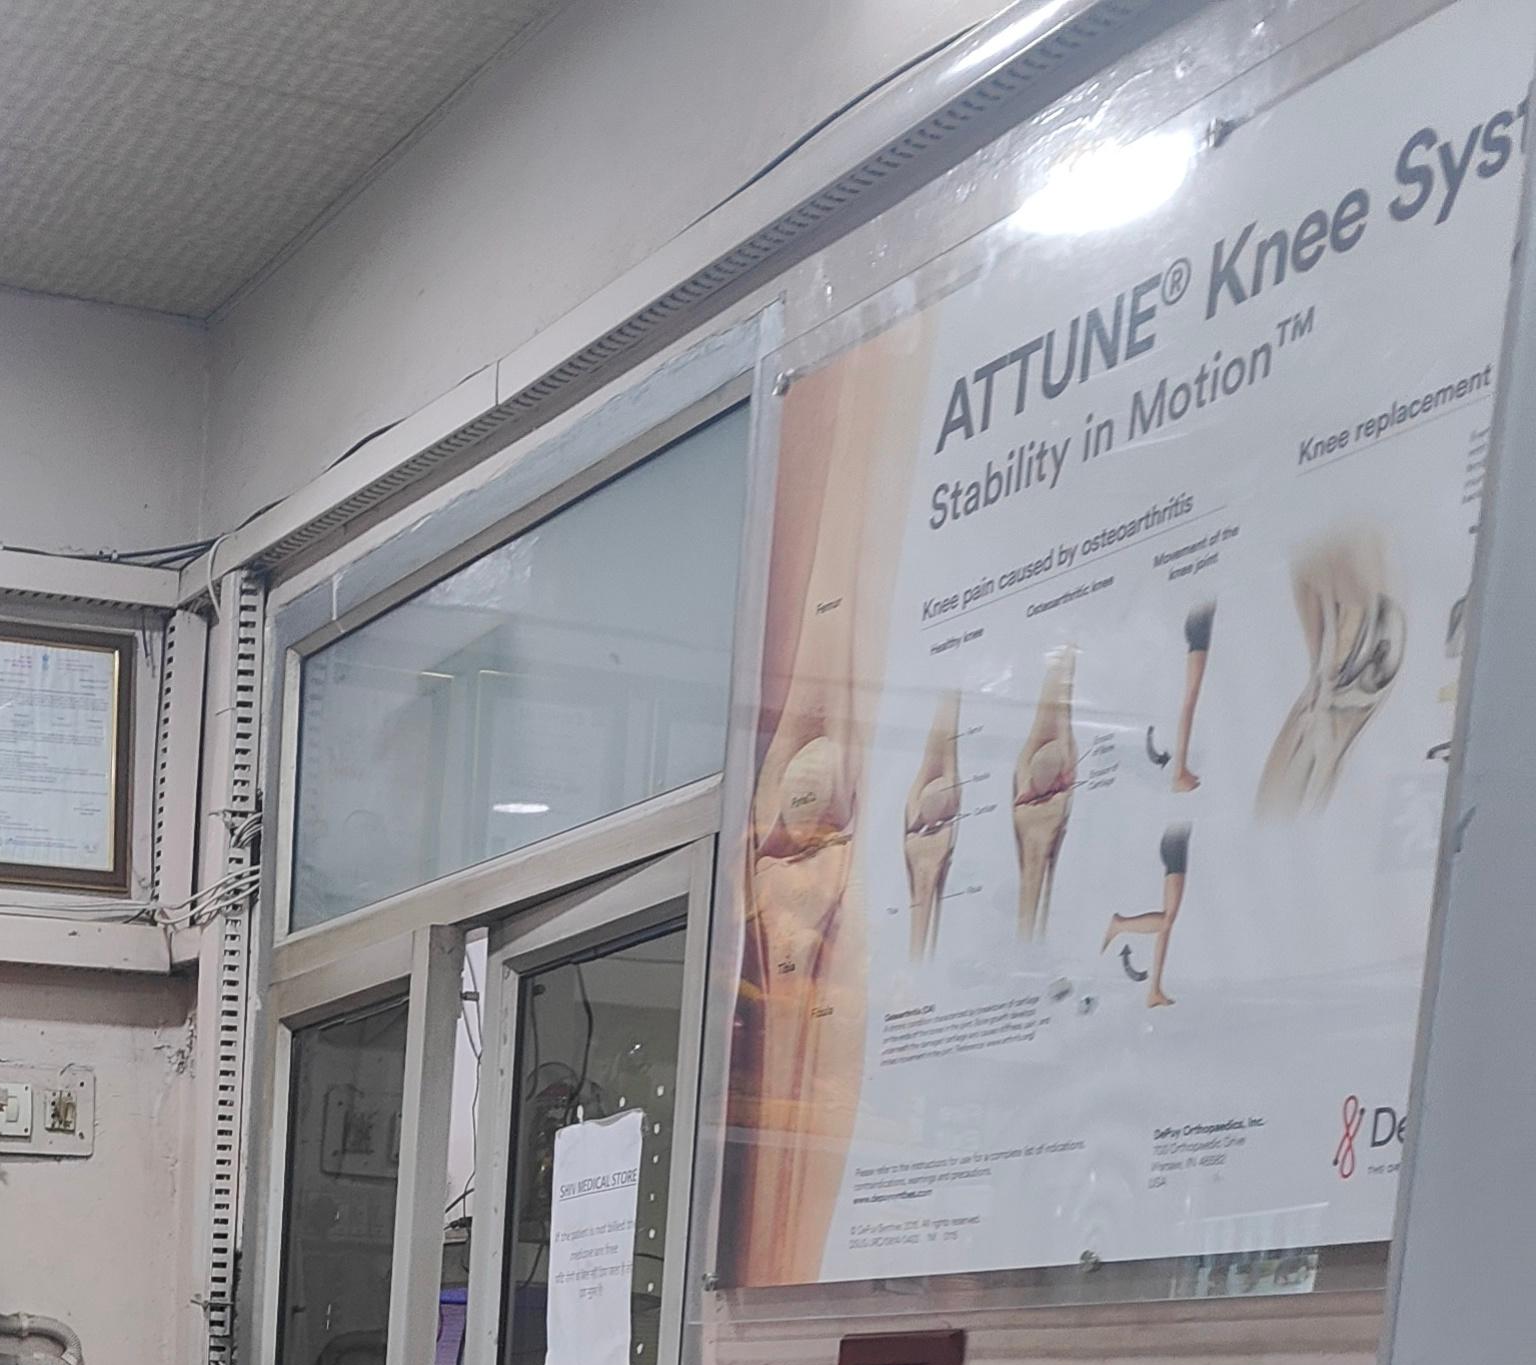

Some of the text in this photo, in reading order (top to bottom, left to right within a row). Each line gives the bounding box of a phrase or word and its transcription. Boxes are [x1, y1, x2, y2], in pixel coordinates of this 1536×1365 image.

[1205, 188, 1370, 320] Knee
[929, 437, 1072, 530] Stability
[1082, 412, 1114, 462] in
[1298, 363, 1493, 465] Knee replacement
[921, 492, 1194, 622] Knee pain caused by osteoarthritis
[577, 1173, 611, 1194] MEDICAL
[611, 1167, 638, 1187] STORE
